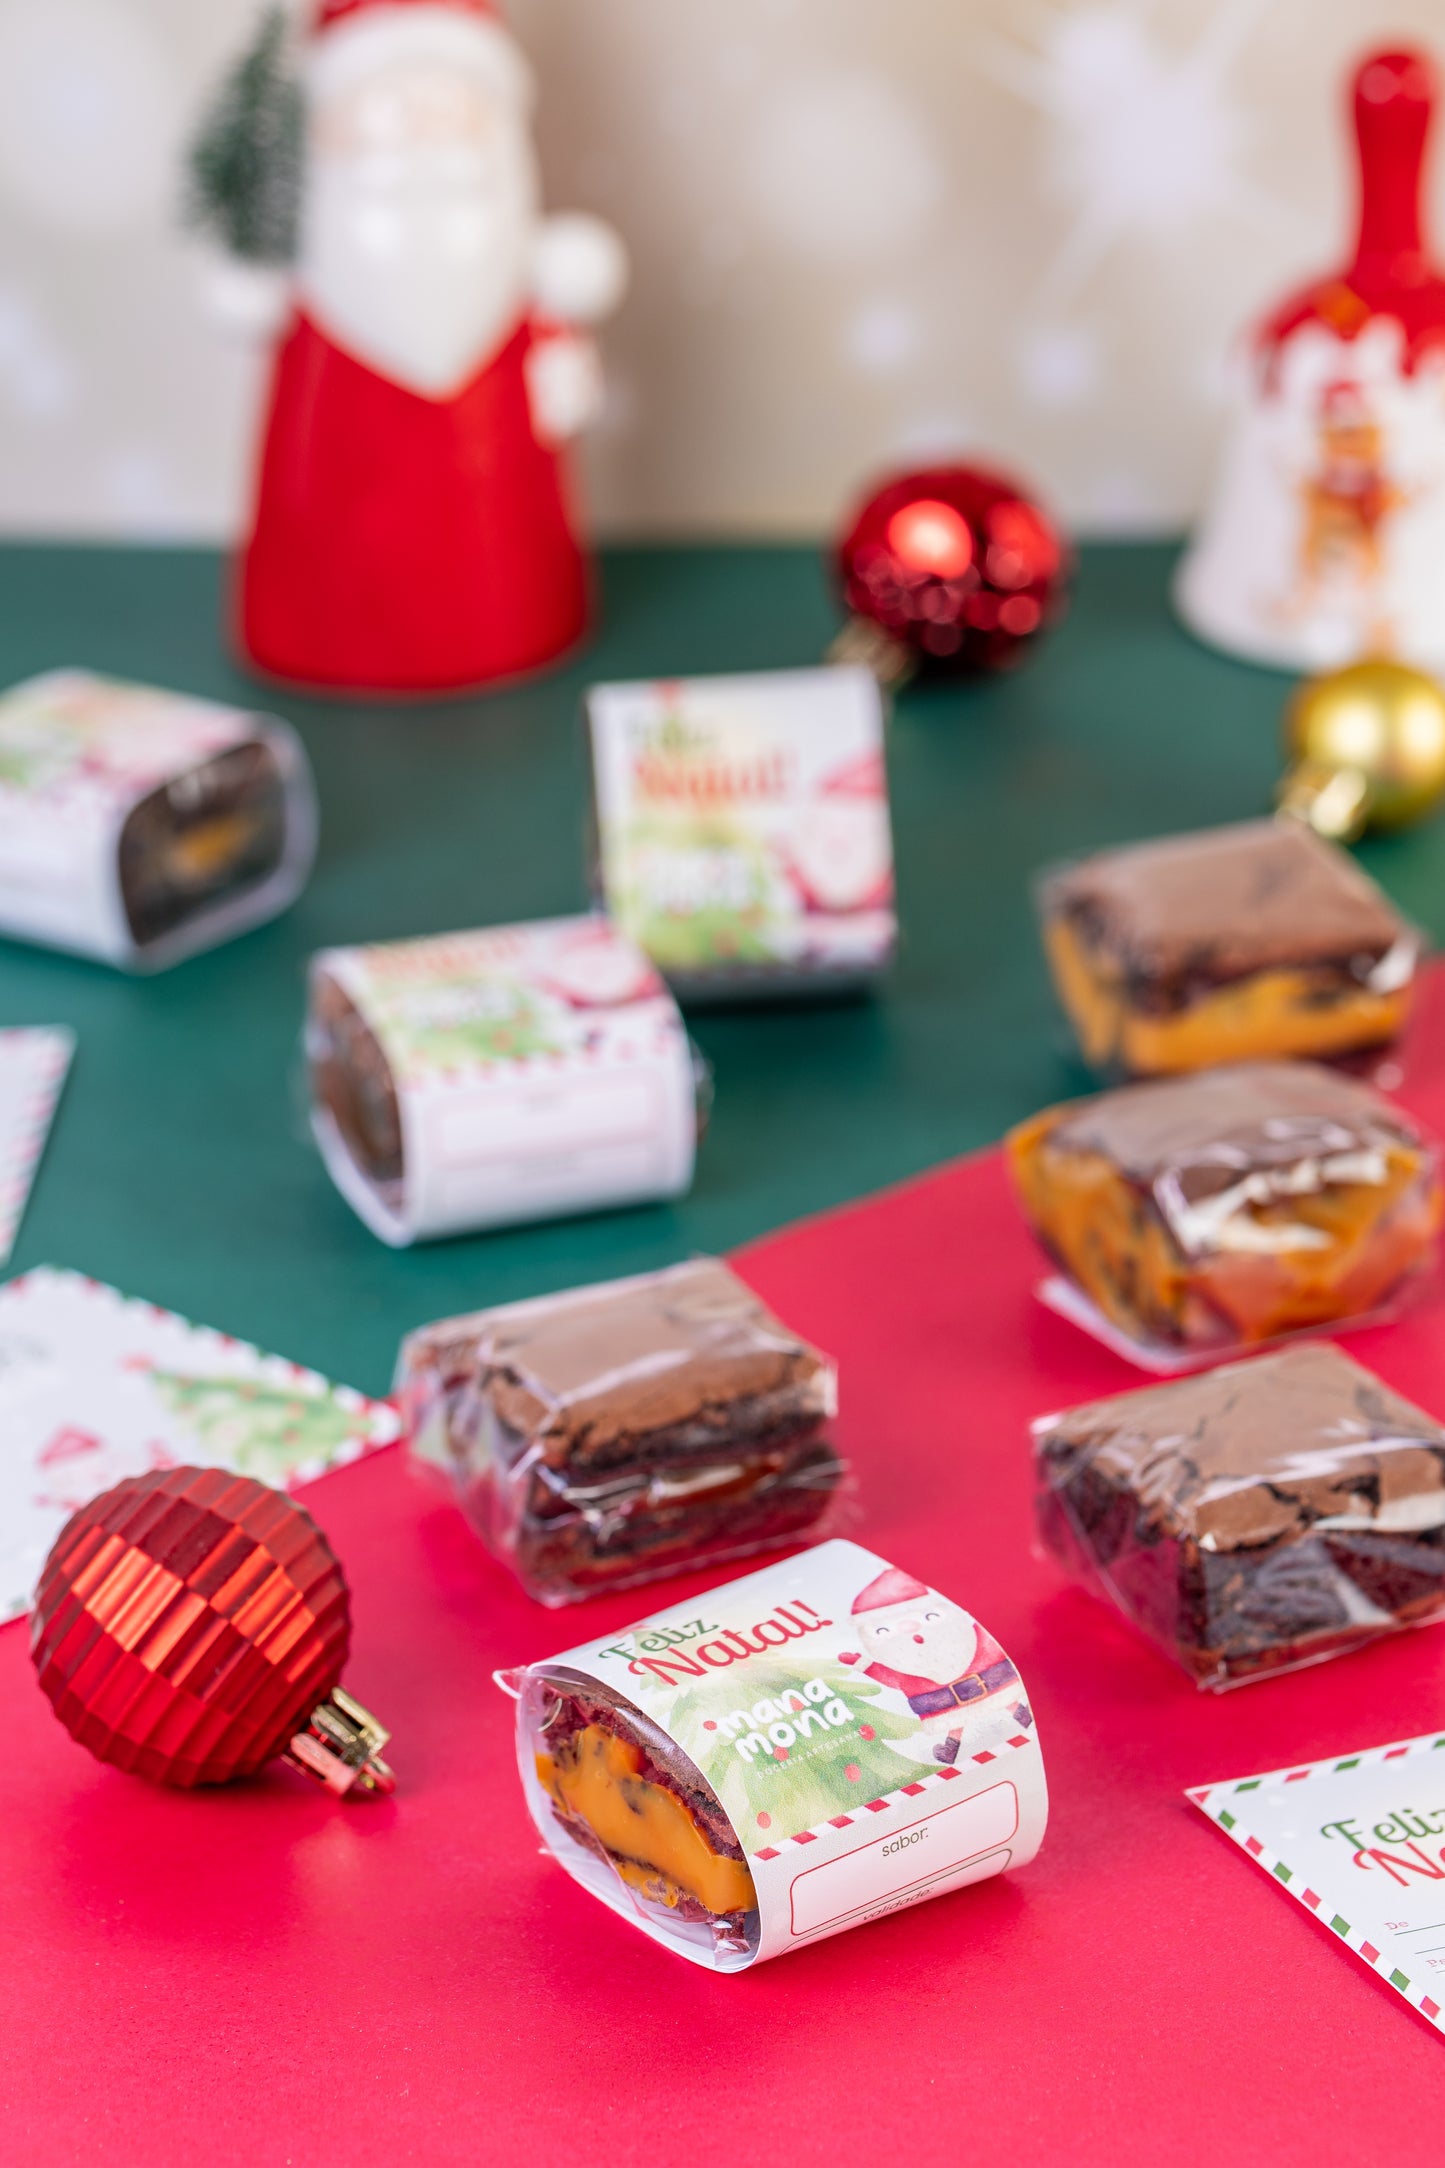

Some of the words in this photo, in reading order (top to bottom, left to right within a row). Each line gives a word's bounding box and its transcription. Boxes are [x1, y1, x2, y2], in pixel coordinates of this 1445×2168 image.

[598, 1618, 719, 1662] Feliz
[627, 1599, 834, 1687] Natal!
[717, 1678, 836, 1739] mana
[735, 1698, 855, 1763] mona
[882, 1827, 929, 1857] sabor:
